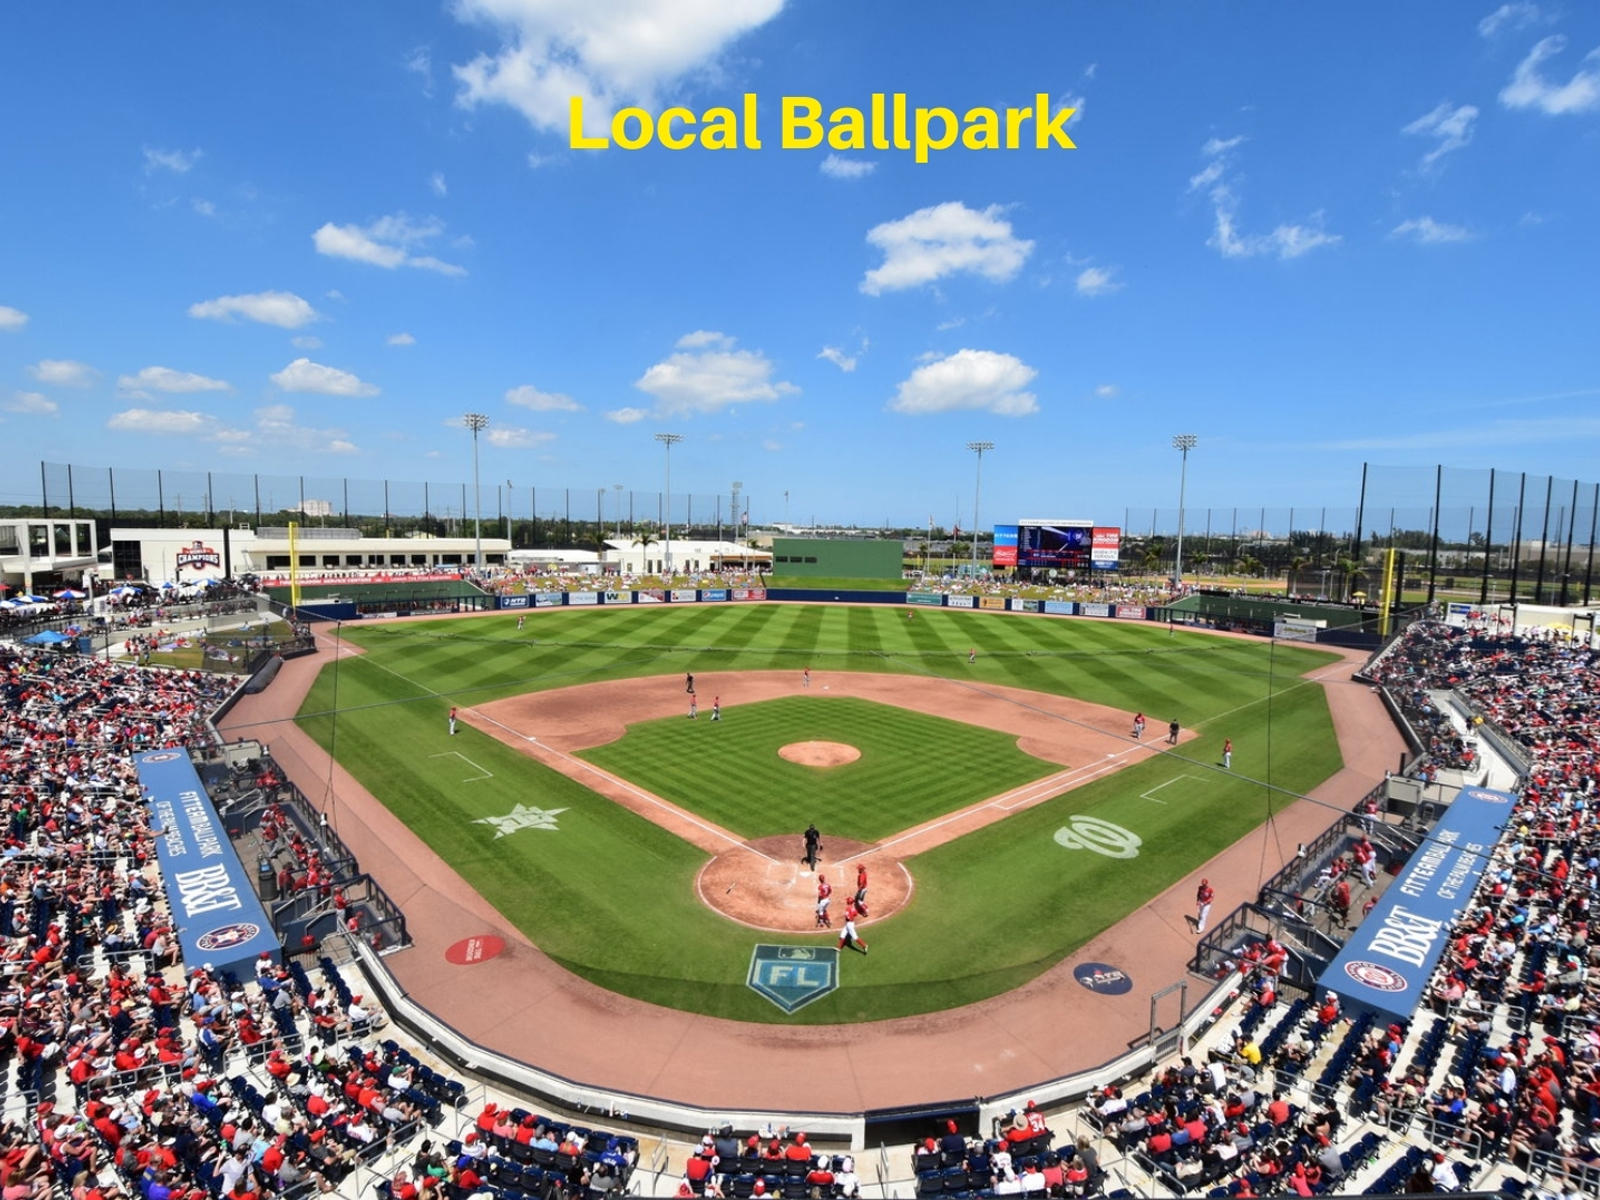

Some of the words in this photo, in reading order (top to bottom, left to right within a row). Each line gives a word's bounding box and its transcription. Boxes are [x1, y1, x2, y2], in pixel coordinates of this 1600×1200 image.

[175, 863, 242, 919] BB&T
[1367, 905, 1445, 968] BB&T
[769, 966, 819, 987] FL
